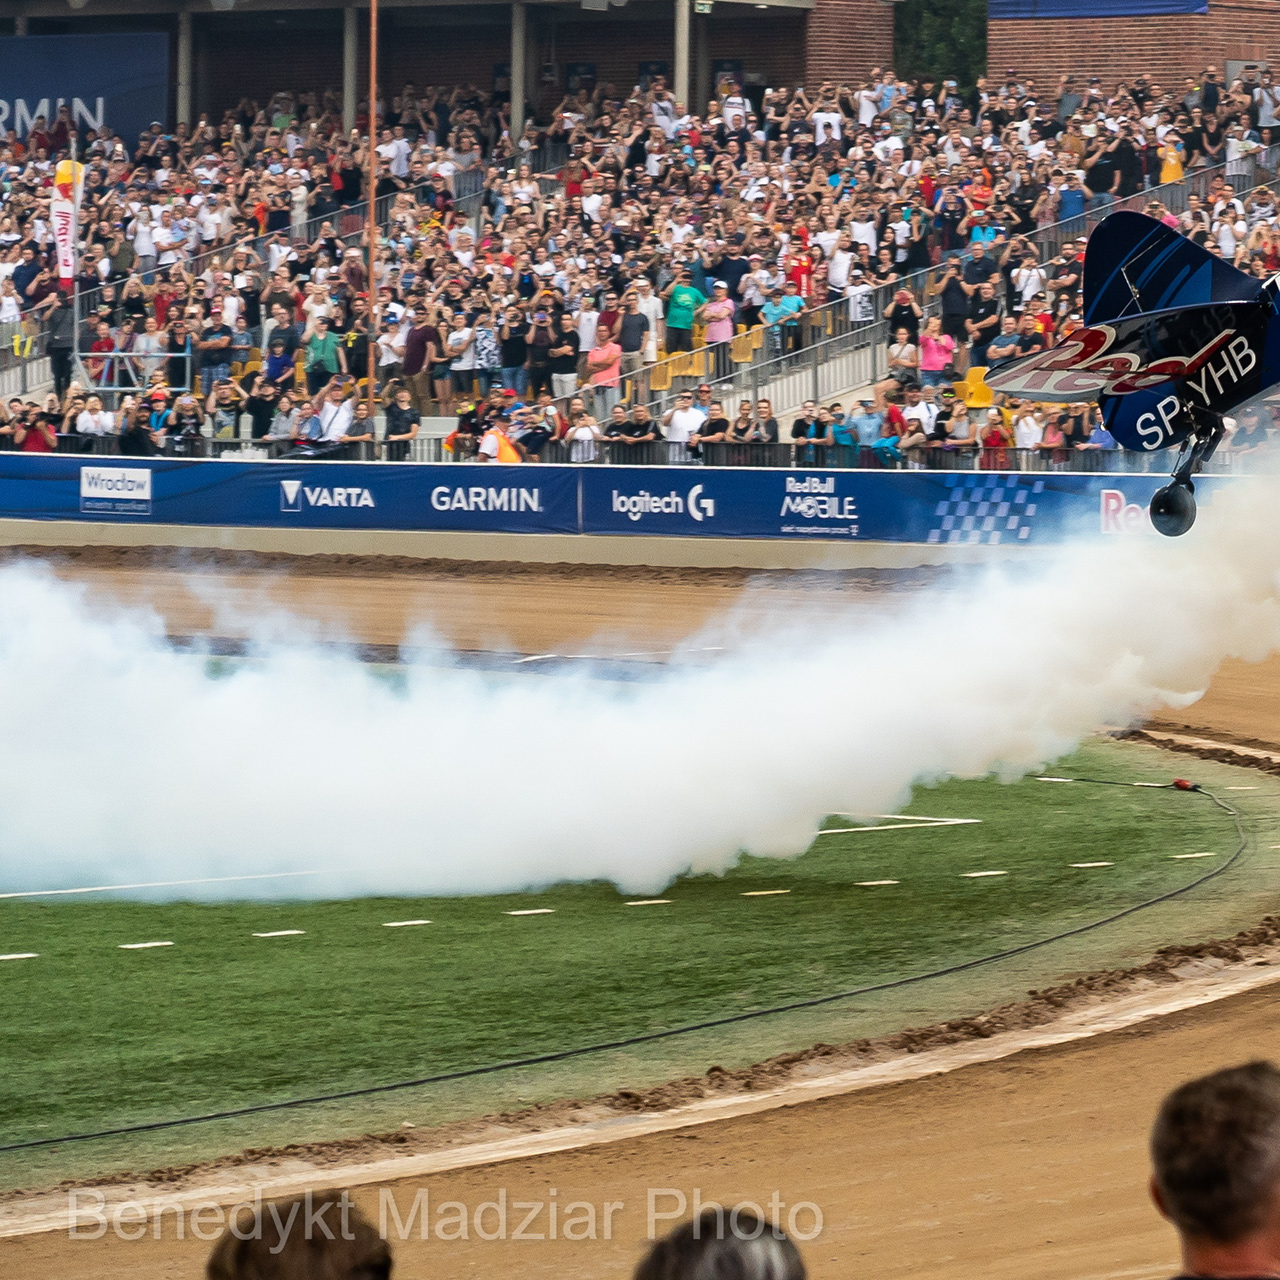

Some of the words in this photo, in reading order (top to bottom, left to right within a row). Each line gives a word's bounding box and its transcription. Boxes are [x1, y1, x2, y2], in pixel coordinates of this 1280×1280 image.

[1135, 335, 1258, 451] SP-YHB
[304, 488, 375, 508] VARTA
[431, 487, 540, 513] GARMIN
[612, 490, 683, 521] logitech
[780, 496, 859, 519] MOBILE
[1101, 489, 1152, 535] Re
